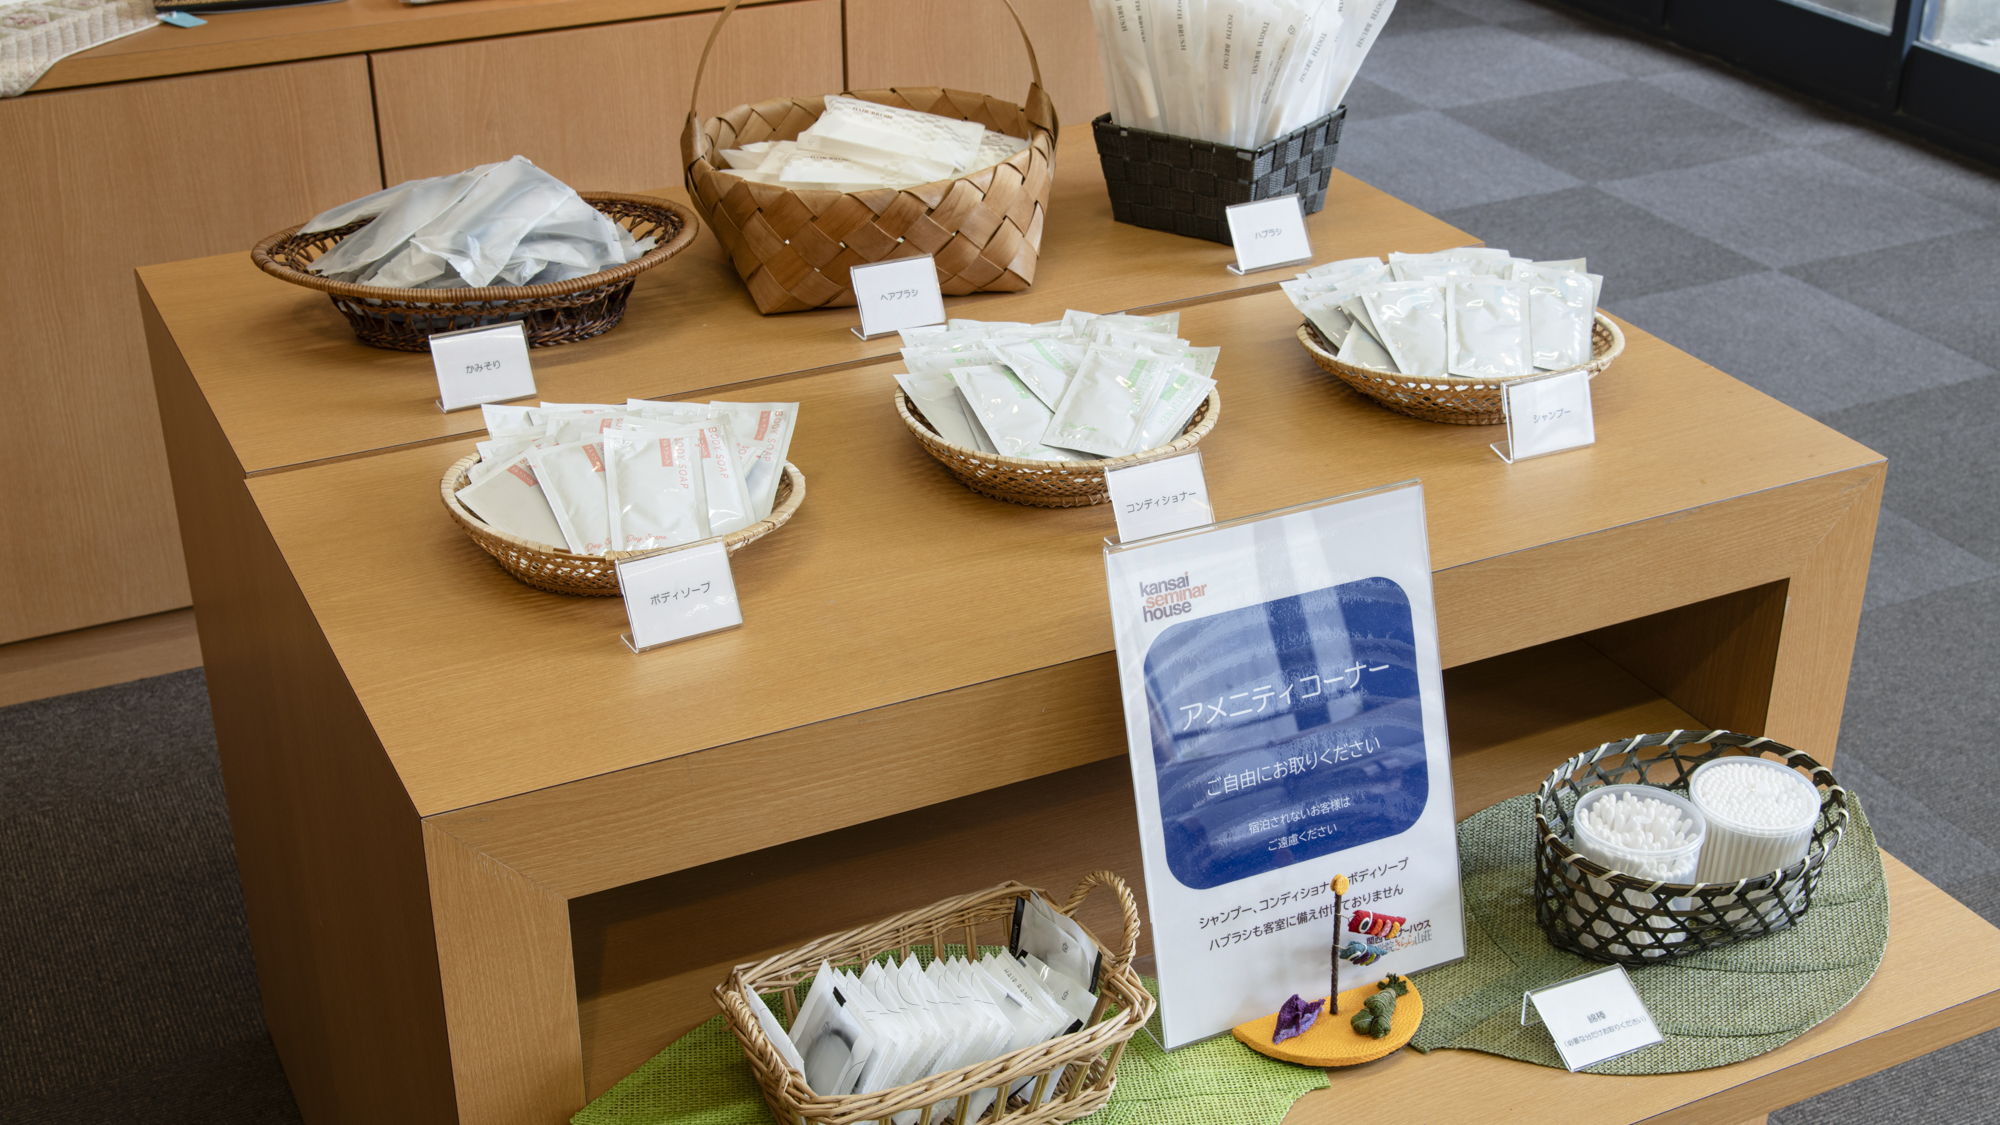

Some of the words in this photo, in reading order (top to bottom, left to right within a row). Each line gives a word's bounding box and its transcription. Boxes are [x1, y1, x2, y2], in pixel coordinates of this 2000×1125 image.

[1117, 5, 1128, 32] BRUSH
[1370, 0, 1387, 20] OOTH
[1177, 24, 1187, 51] BRUSH
[1225, 14, 1234, 41] TOOTH
[1257, 21, 1270, 47] TOOTH
[1355, 22, 1373, 48] BRUSH
[1223, 43, 1231, 70] BRUSH
[1311, 32, 1327, 57] TOOTH
[1251, 50, 1262, 75] BRUSH
[1298, 58, 1314, 84] BRUSH
[1255, 228, 1283, 240] ハブラシ
[880, 289, 919, 301] ヘアブラシ
[465, 360, 501, 374] かみそり
[1157, 379, 1200, 426] CONDITIONER
[771, 410, 784, 435] BODY
[1533, 408, 1571, 424] シャンプー
[708, 426, 723, 451] BODY
[716, 454, 729, 479] SOAP
[762, 437, 776, 462] SOAP
[677, 463, 689, 489] SOAP
[1126, 491, 1197, 514] コンディショナー
[585, 540, 603, 552] Day
[625, 534, 643, 543] Day
[650, 581, 711, 606] ボディソープ
[1139, 571, 1190, 598] kansai
[1145, 583, 1208, 609] seminar
[1142, 600, 1192, 623] house
[1179, 661, 1390, 731] アメニティコーナー
[1207, 737, 1381, 796] ご自由にお取りください
[1248, 796, 1351, 834] 宿泊されないお客様は
[1268, 823, 1338, 851] ご遠慮ください
[1199, 857, 1409, 930] シャンプー、コンディショナボディソープ
[1366, 919, 1432, 945] 関西ナーハウス
[1586, 1010, 1607, 1024] 綿棒
